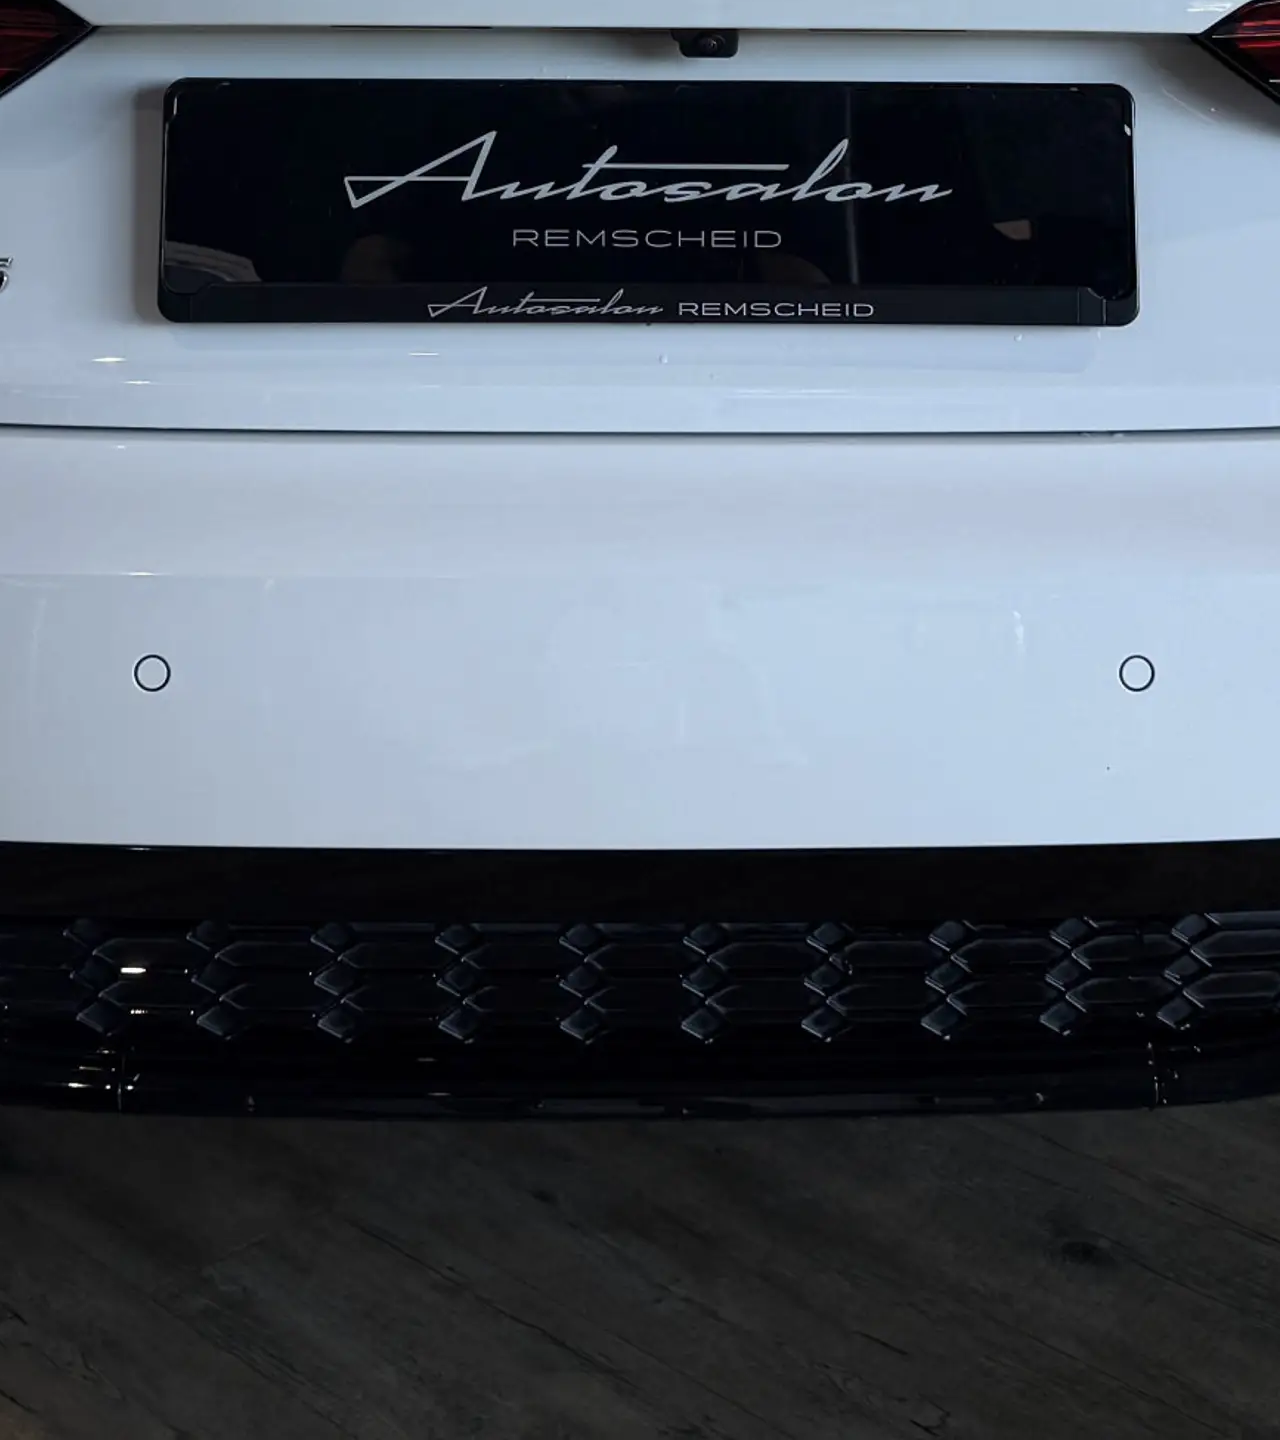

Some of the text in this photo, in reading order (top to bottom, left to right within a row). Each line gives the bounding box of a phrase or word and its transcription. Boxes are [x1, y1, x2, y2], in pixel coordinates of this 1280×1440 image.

[343, 130, 954, 209] Autosalon
[512, 228, 782, 249] REMSCHEID
[427, 286, 875, 318] Autosalon REMSCHEID
